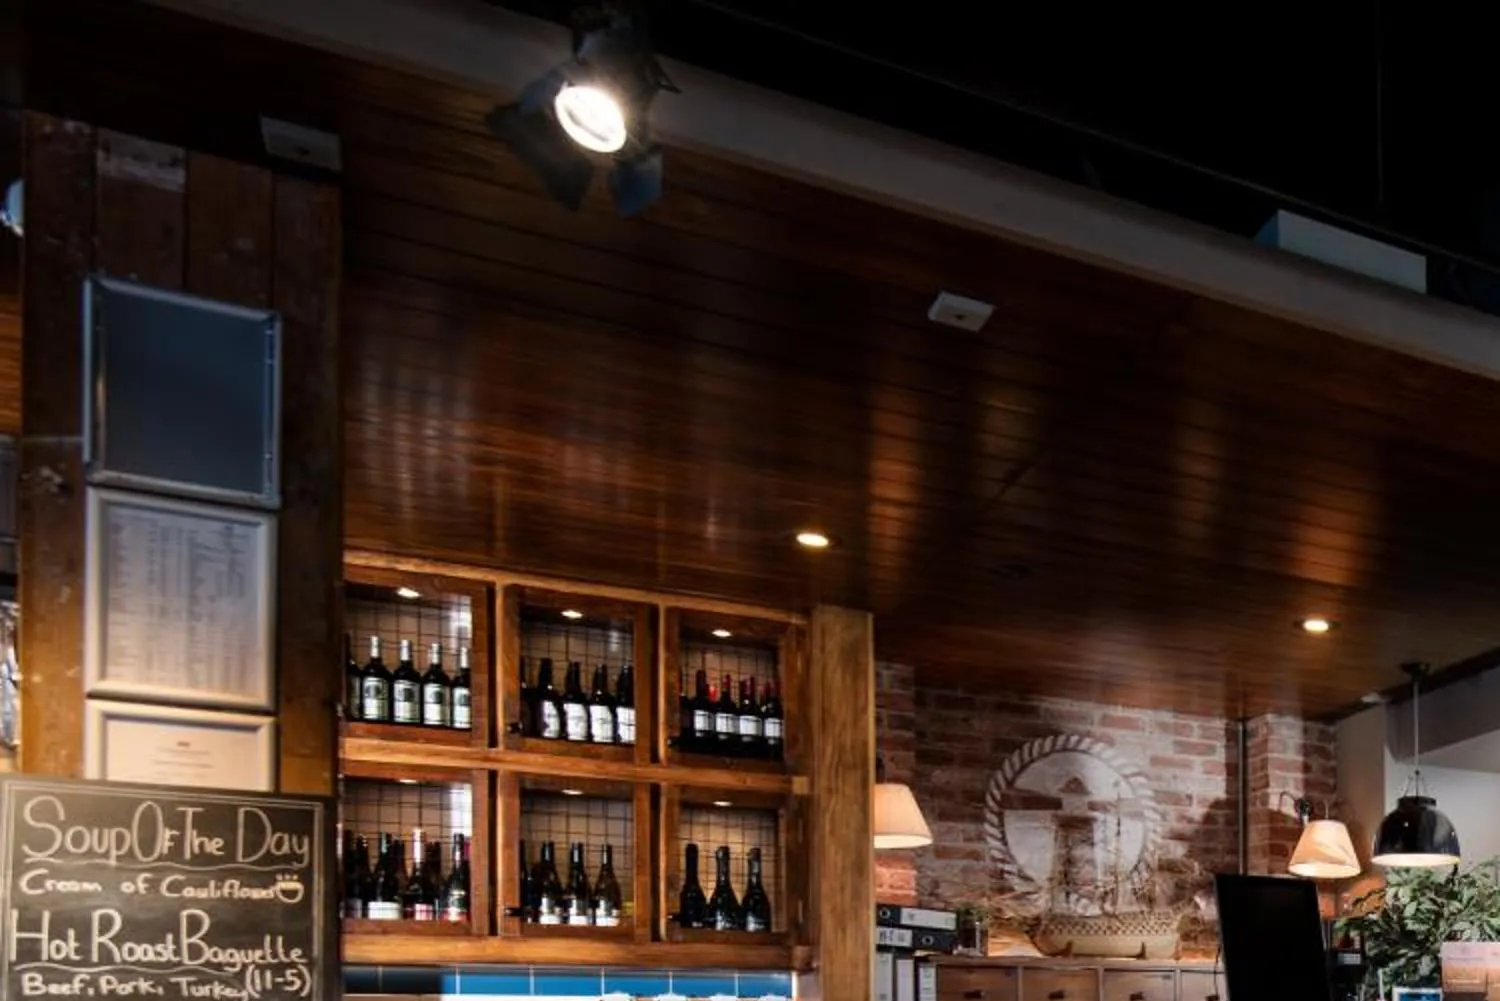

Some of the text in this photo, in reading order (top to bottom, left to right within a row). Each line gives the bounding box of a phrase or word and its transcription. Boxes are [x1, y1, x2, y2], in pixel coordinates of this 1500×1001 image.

[22, 794, 131, 867] Soup
[176, 808, 225, 861] The
[236, 807, 310, 869] Day
[120, 873, 153, 894] of
[9, 908, 308, 972] Hot Roast Baguette
[246, 964, 311, 998] (11-5)
